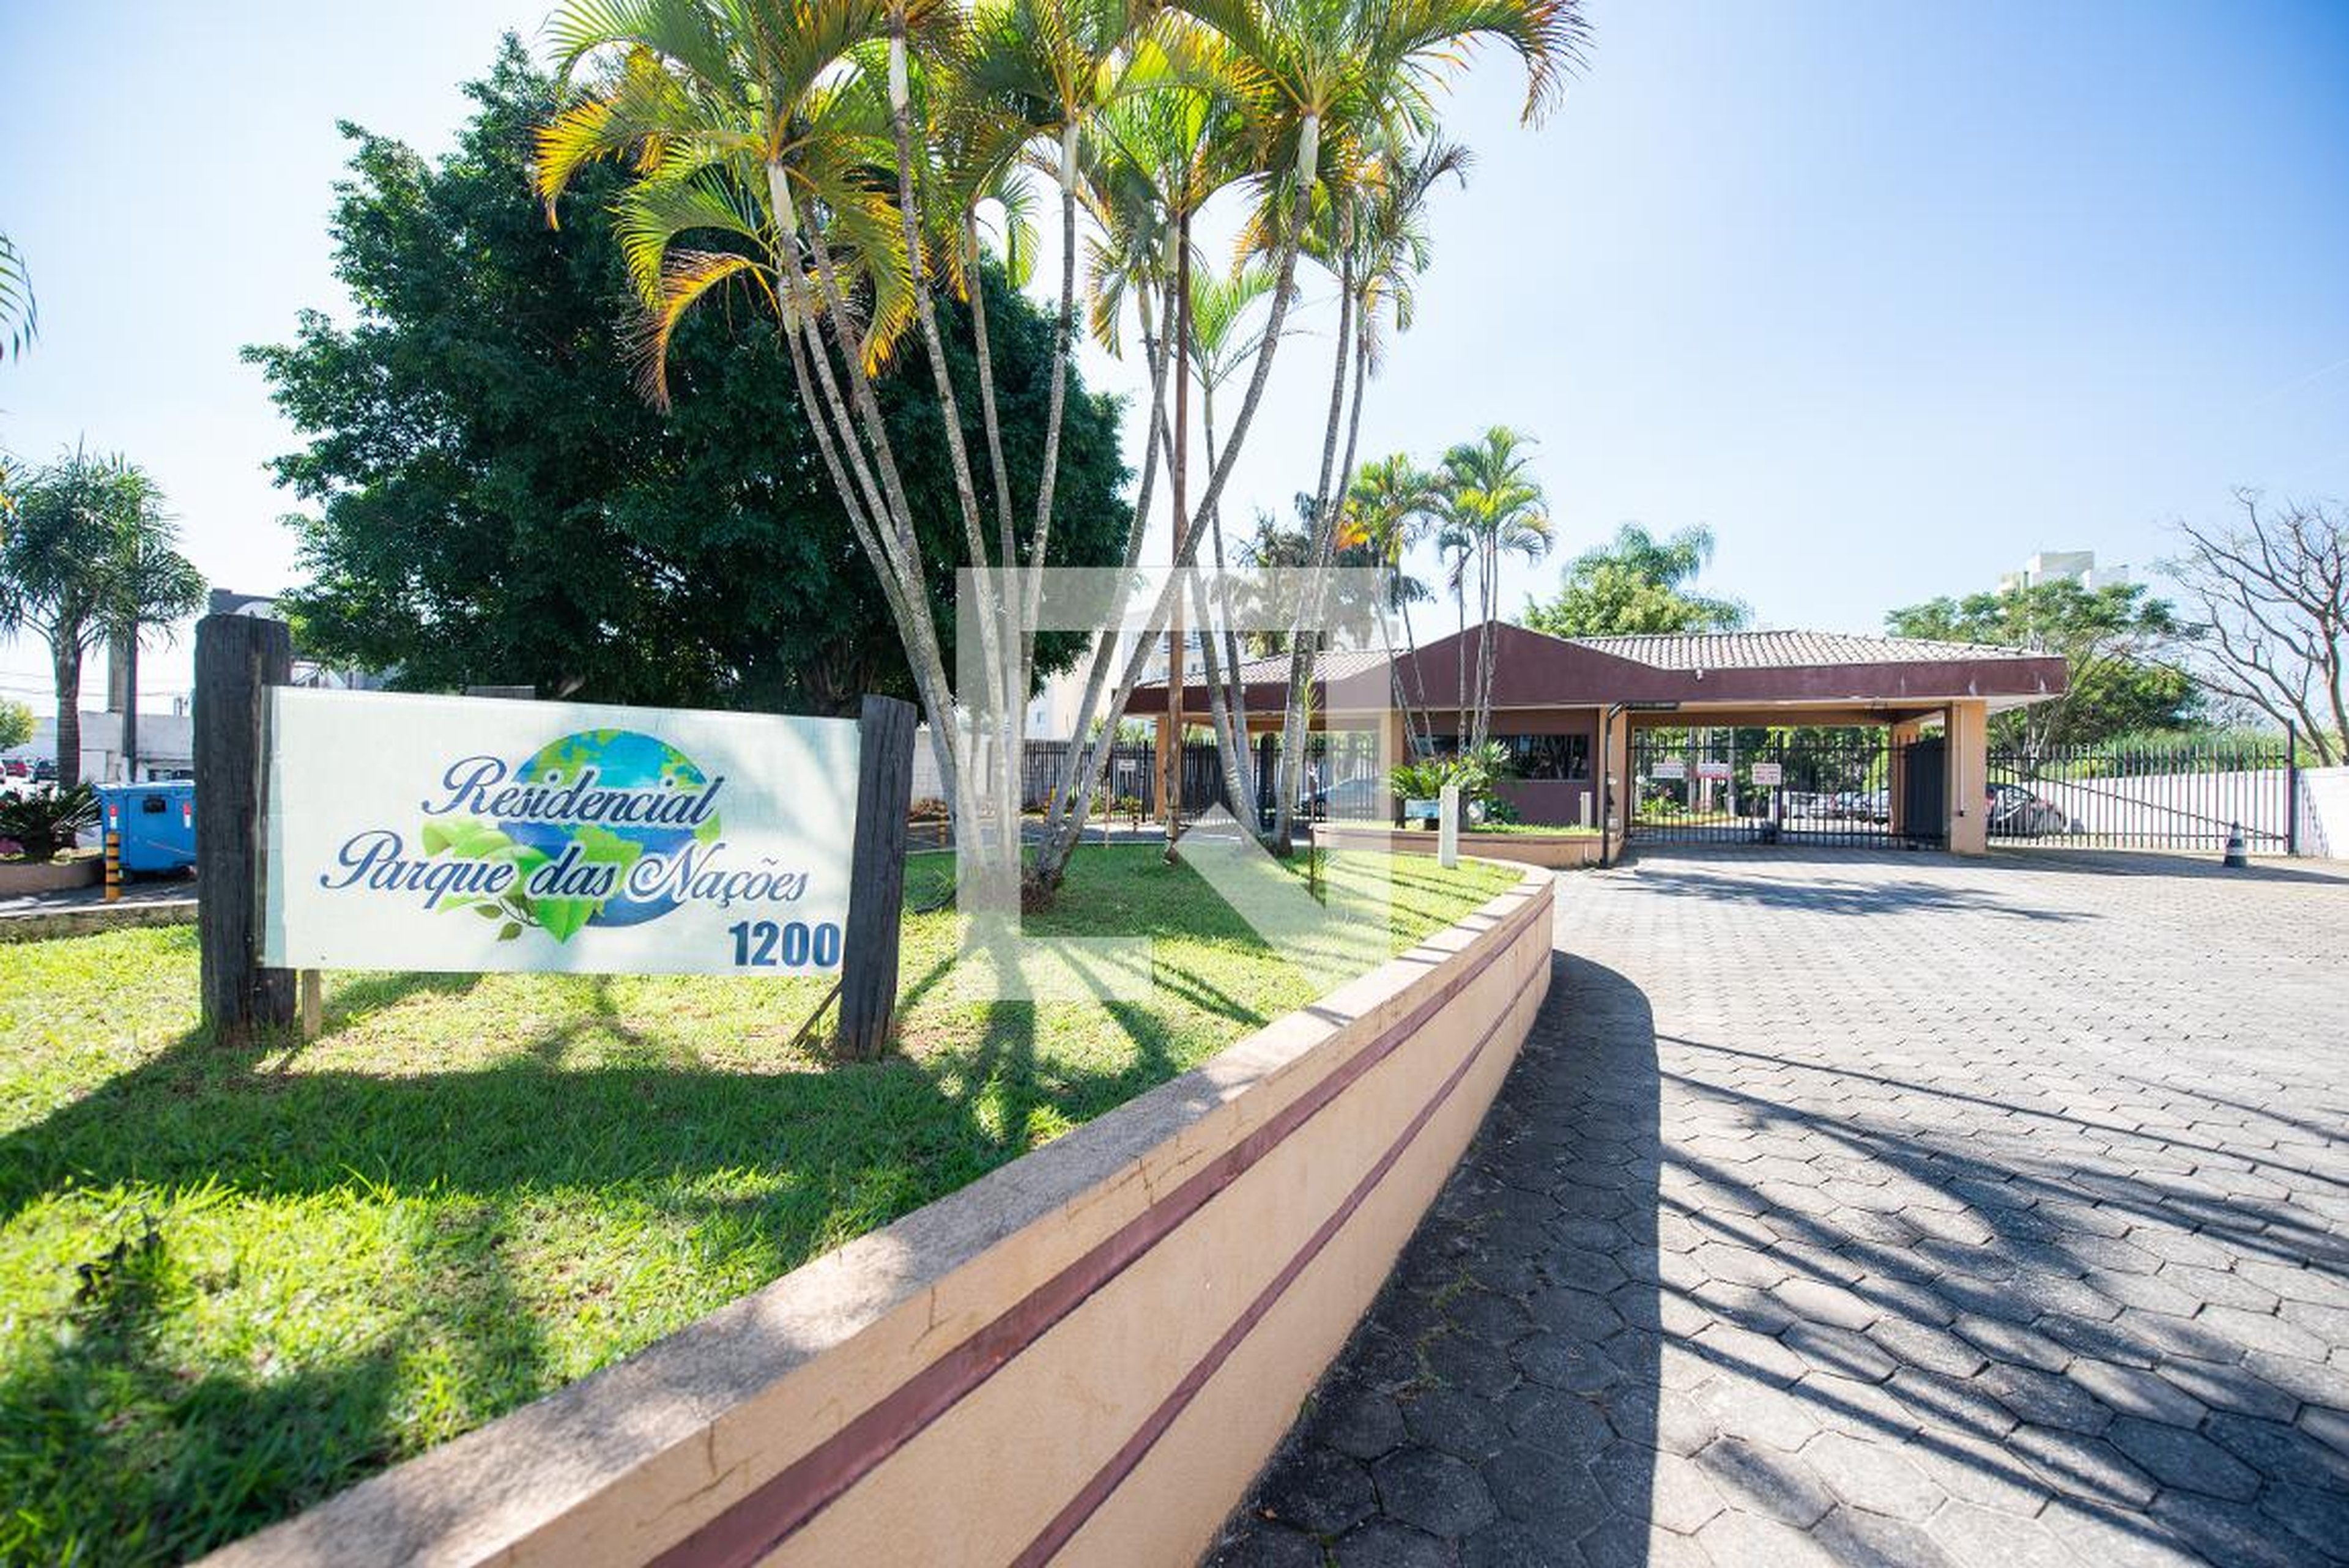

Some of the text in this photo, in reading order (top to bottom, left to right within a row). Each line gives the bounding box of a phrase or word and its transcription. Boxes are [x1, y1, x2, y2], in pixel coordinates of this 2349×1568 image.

[423, 756, 725, 826] Residencial
[320, 830, 809, 909] Parque das Nações
[730, 920, 841, 967] 1200
